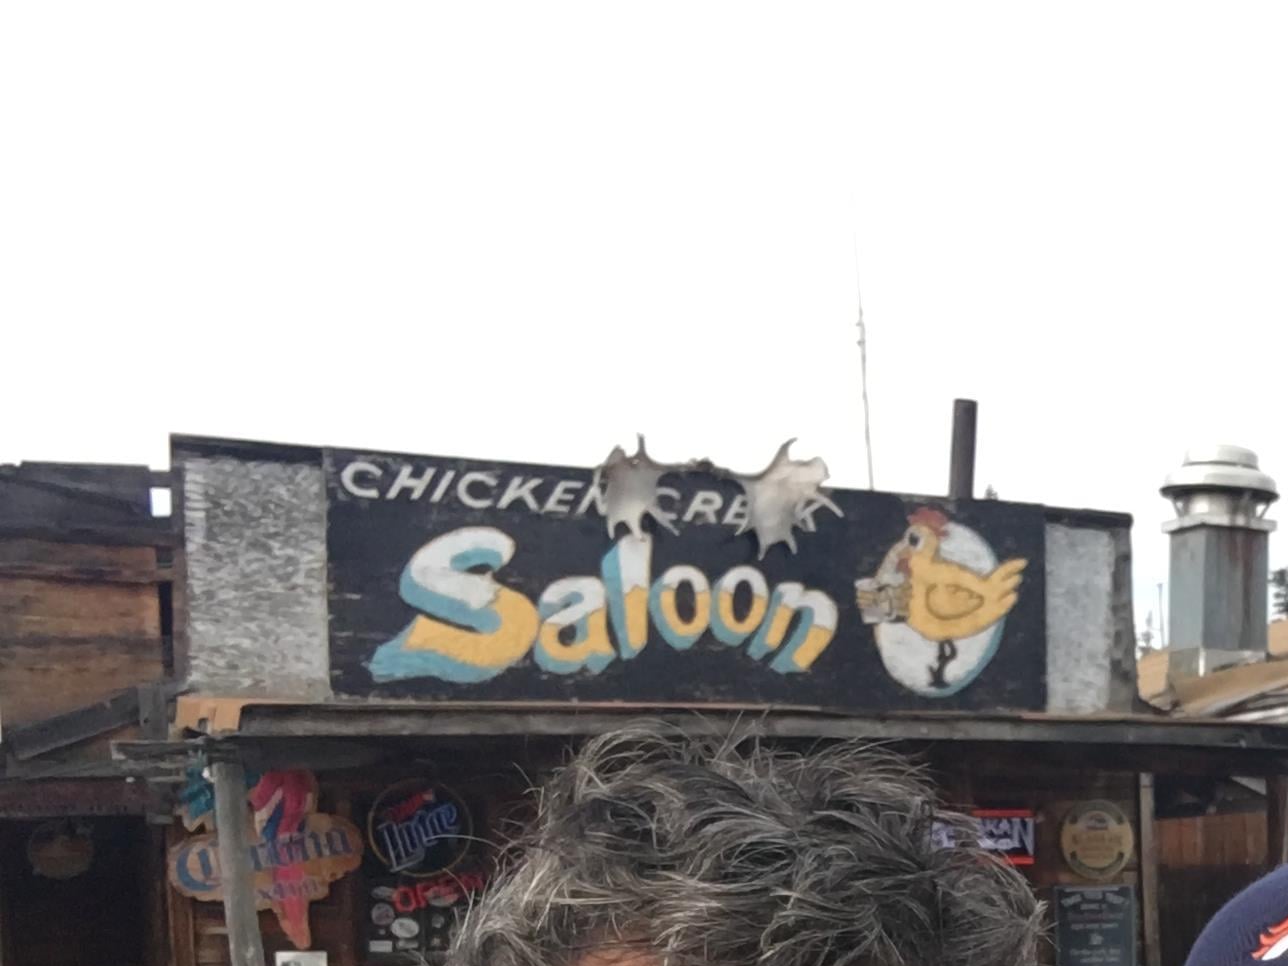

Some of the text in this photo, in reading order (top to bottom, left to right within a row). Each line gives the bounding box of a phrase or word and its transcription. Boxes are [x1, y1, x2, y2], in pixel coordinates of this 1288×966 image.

[341, 460, 826, 532] CHICKEN CREK
[372, 527, 838, 682] Saloon
